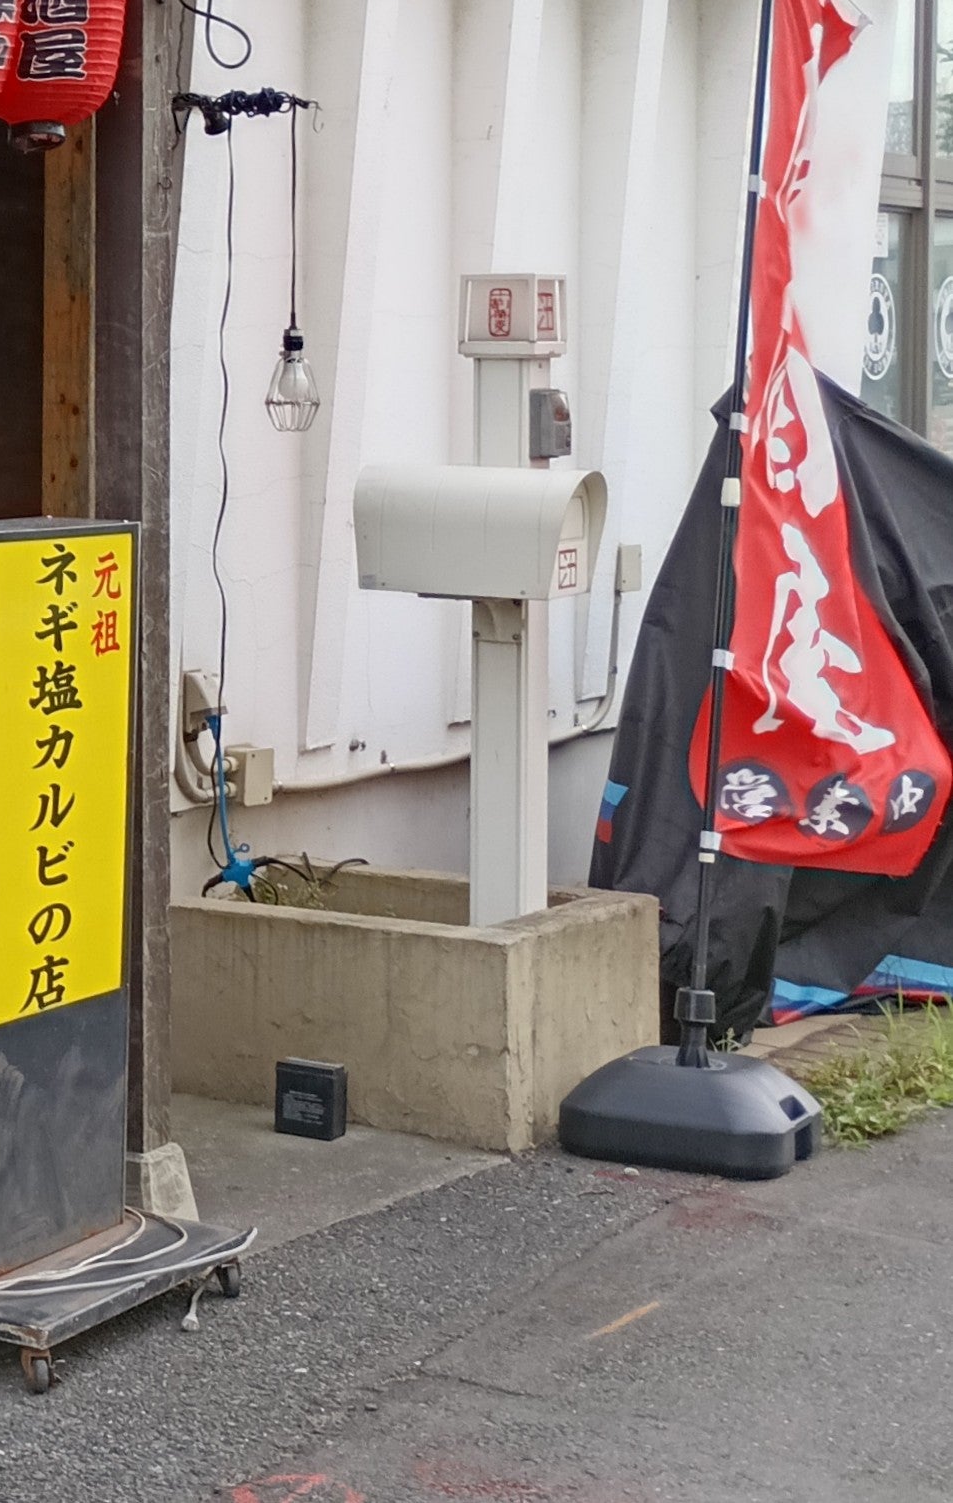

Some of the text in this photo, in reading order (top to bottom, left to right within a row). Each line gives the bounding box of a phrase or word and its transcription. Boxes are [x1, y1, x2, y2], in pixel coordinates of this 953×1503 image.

[90, 550, 122, 657] 元祖
[19, 543, 83, 1014] ネギ塩カルビの店
